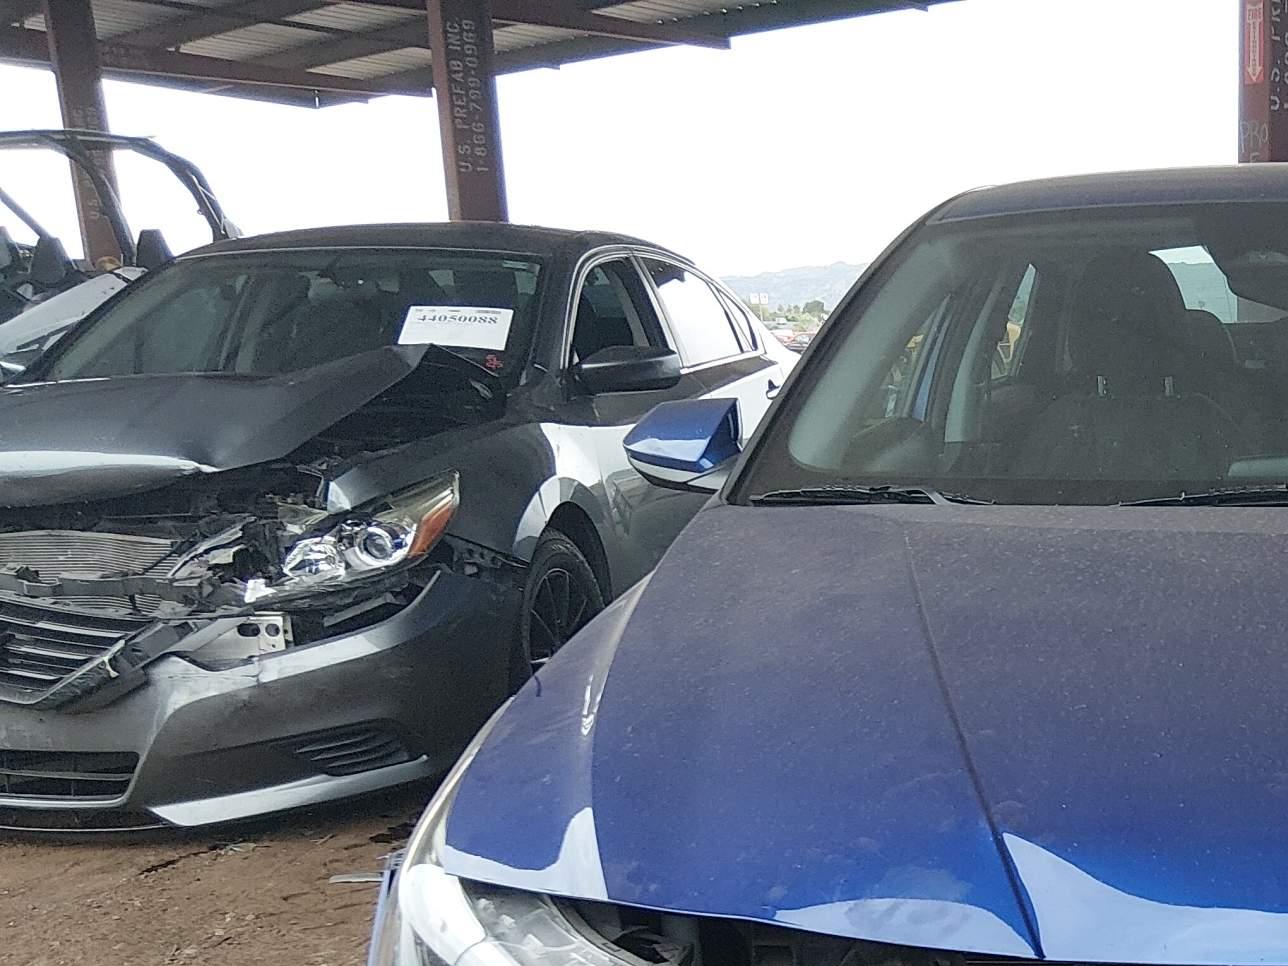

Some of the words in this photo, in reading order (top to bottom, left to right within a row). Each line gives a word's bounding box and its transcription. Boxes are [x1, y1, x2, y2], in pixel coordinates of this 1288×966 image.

[446, 17, 460, 51] INC.
[449, 60, 468, 129] PREFAB
[463, 19, 488, 173] 1-866-799-0969
[458, 140, 473, 173] U.S.
[417, 314, 499, 325] 44050088
